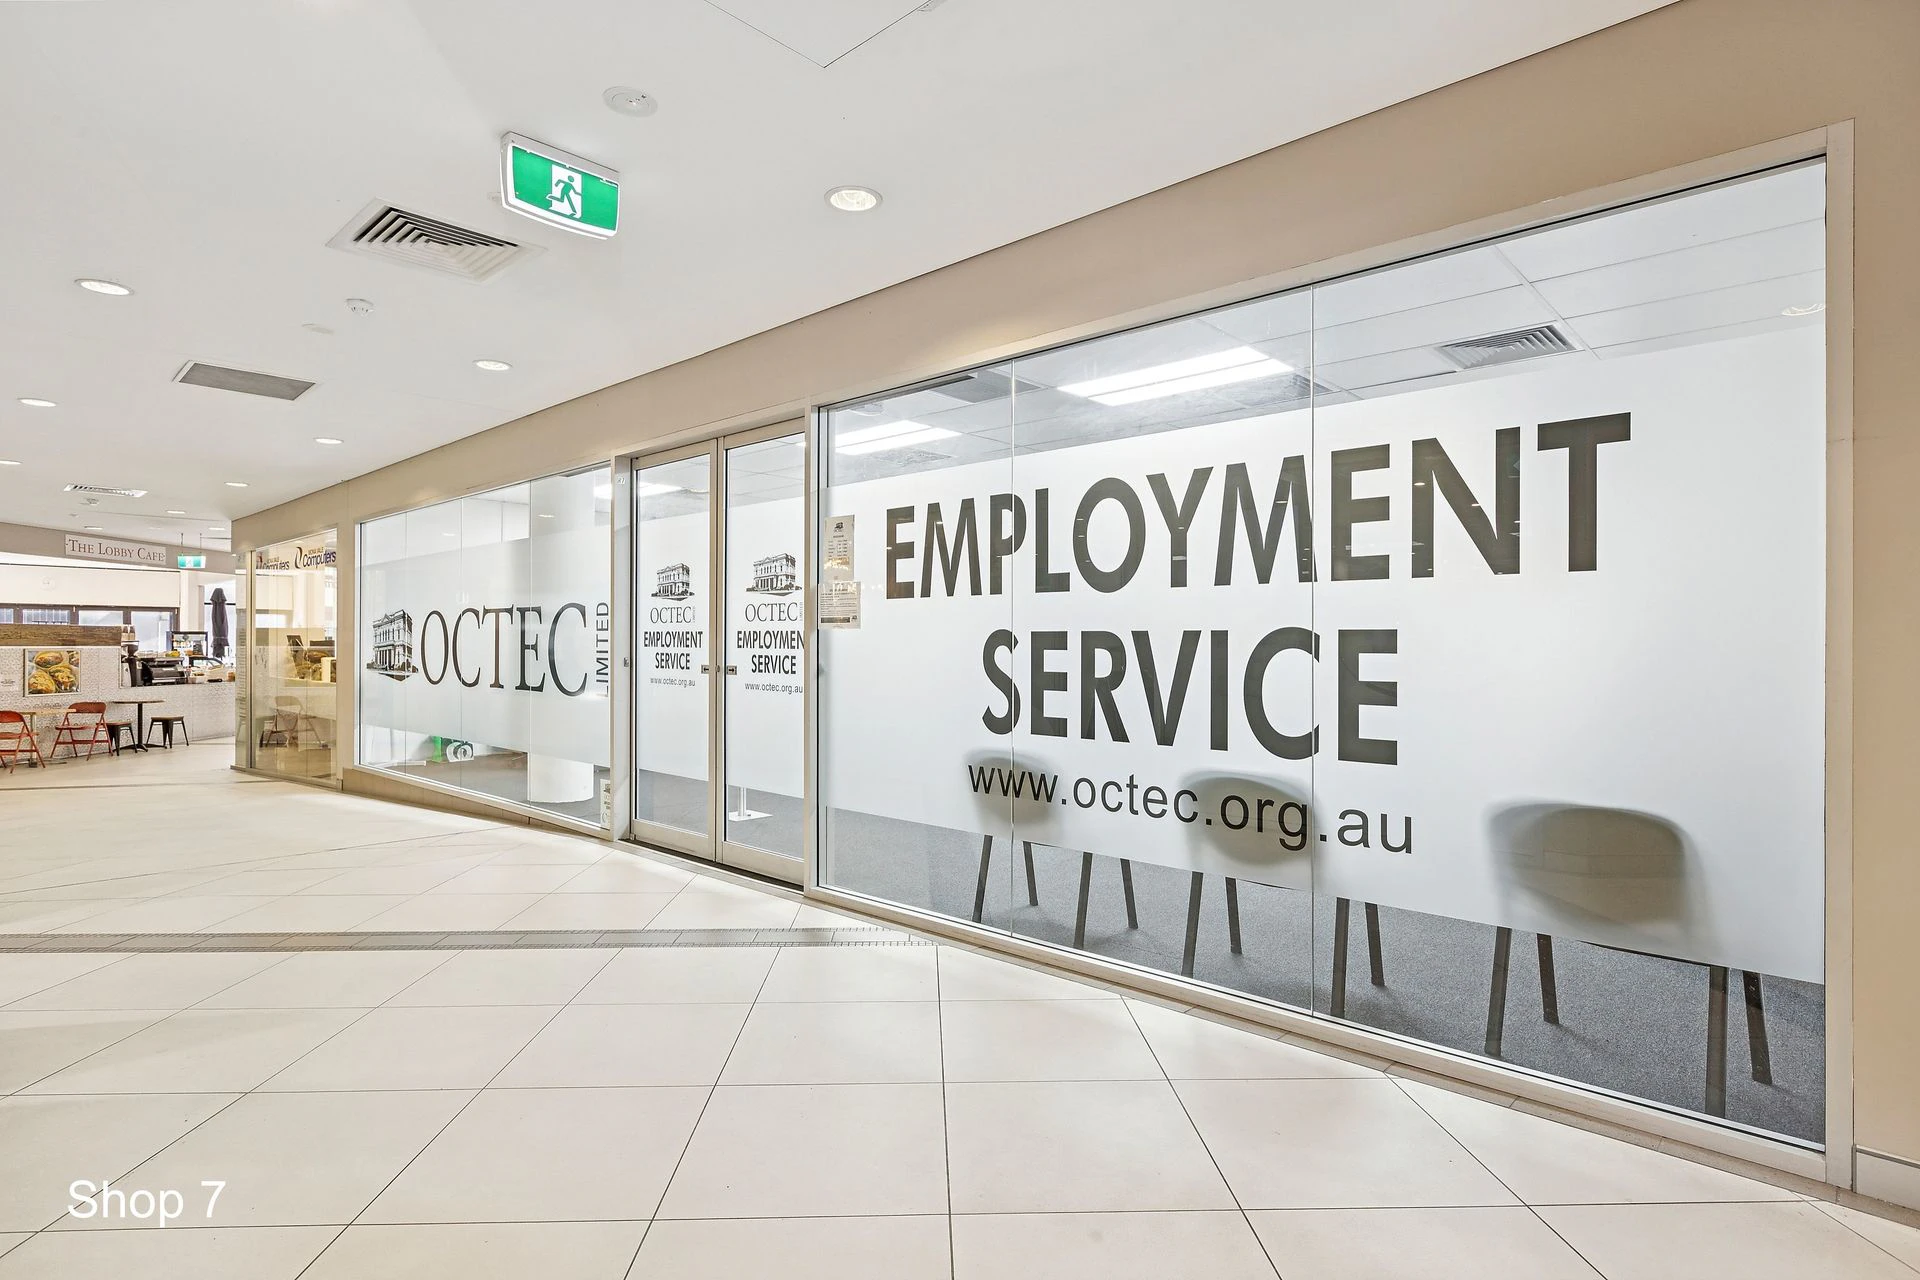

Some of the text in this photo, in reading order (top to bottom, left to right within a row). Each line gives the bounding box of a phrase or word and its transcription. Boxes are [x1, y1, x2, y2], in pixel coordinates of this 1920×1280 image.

[885, 412, 1632, 599] EMPLOYMENT
[69, 539, 164, 562] THE LOBBY CAFE
[303, 551, 337, 569] Computers
[650, 606, 692, 624] OCTEC
[745, 602, 798, 622] OCTEC
[420, 602, 588, 697] OCTEC
[596, 602, 609, 697] LIMITED
[643, 630, 703, 649] EMPLOYMENT
[736, 630, 805, 650] EMPLOYMEN
[655, 652, 690, 670] SERVICE
[751, 655, 797, 675] SERVICE
[745, 682, 804, 695] www.octec.org.au
[981, 626, 1398, 766] SERVICE
[967, 764, 1413, 854] www.octec.org.au
